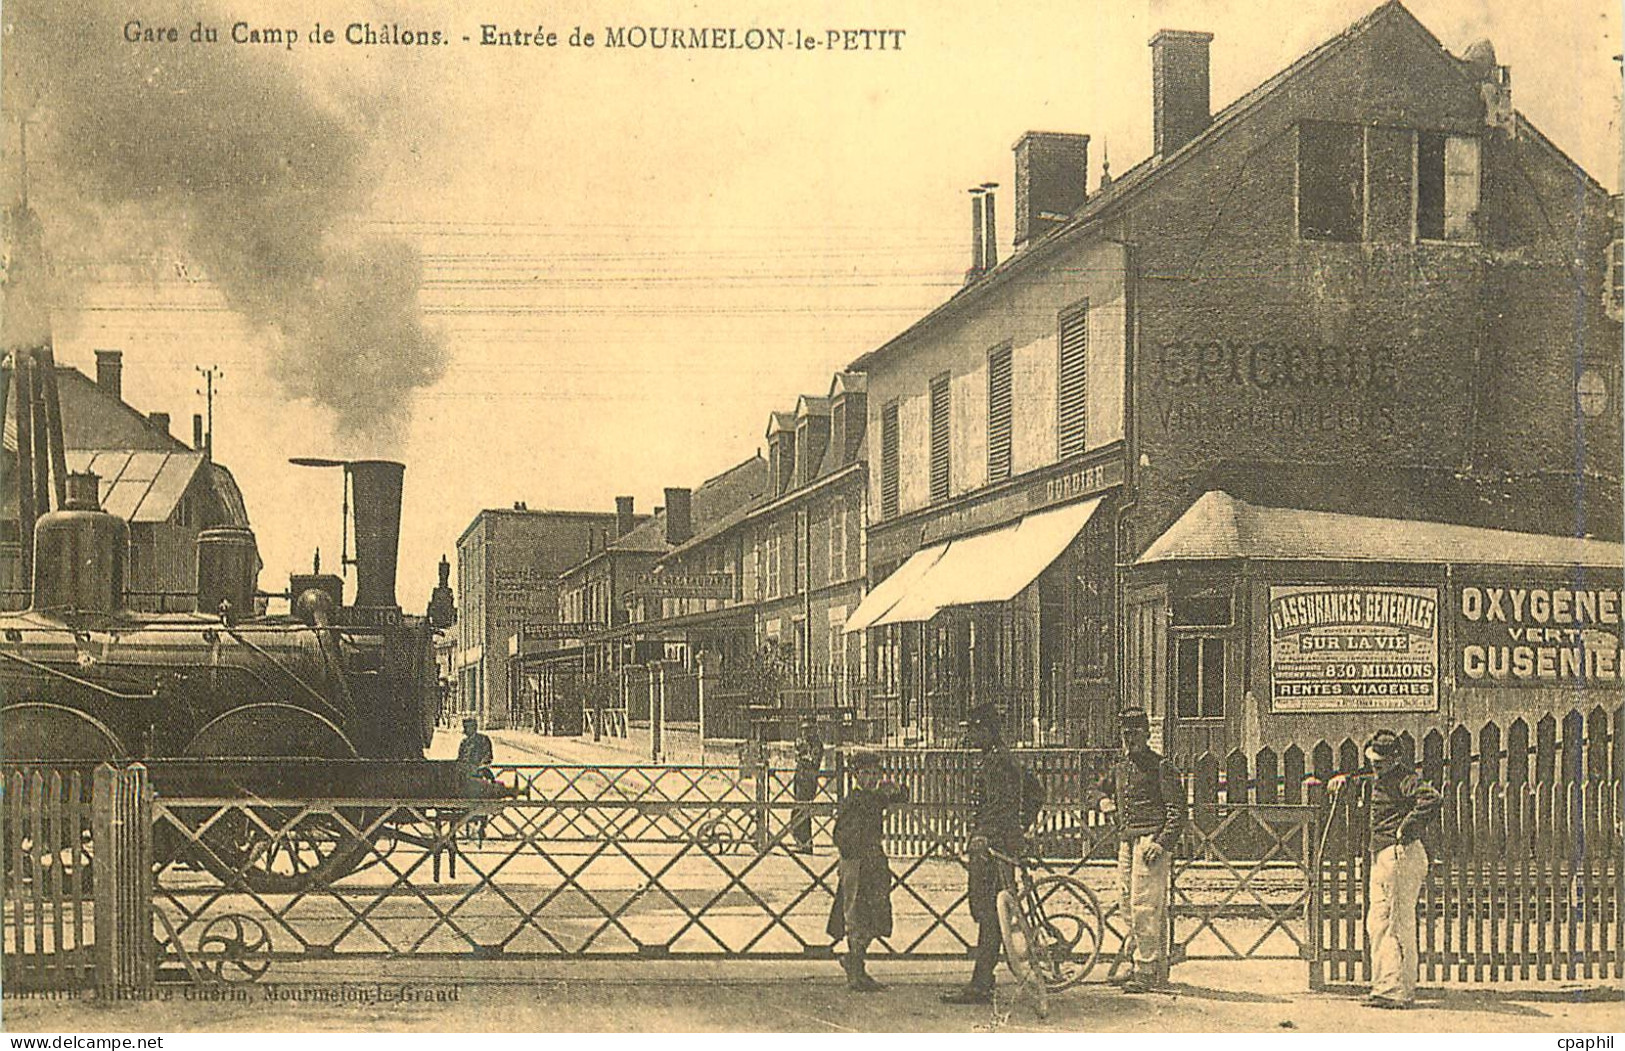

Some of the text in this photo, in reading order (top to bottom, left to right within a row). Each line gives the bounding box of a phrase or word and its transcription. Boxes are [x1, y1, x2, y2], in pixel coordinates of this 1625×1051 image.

[1302, 636, 1340, 649] SUR
[1347, 636, 1372, 649] LA
[1374, 636, 1408, 650] VIE
[1325, 664, 1356, 678] 830
[1361, 664, 1432, 679] MILLIONS
[1280, 683, 1342, 696] RENTES
